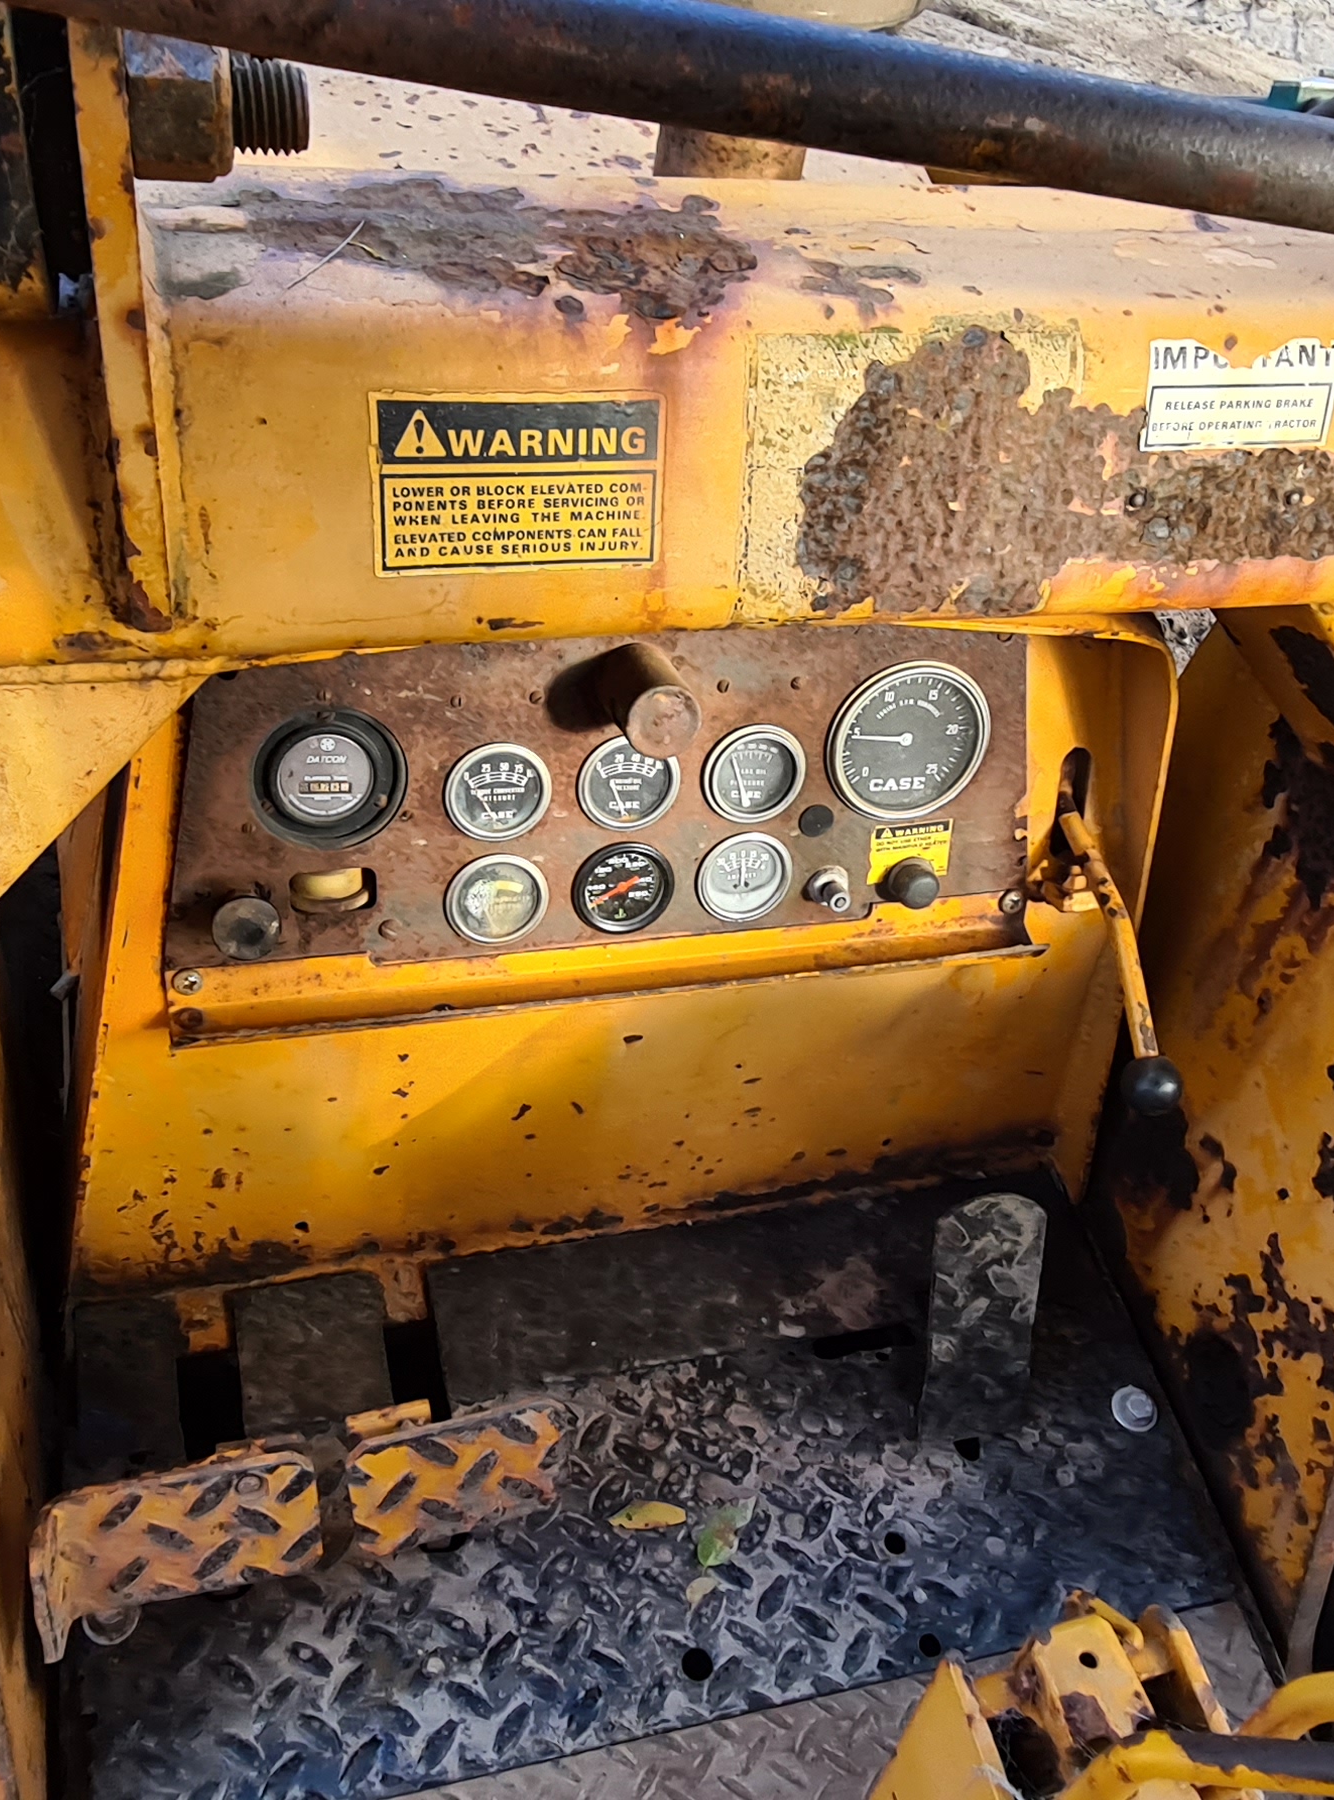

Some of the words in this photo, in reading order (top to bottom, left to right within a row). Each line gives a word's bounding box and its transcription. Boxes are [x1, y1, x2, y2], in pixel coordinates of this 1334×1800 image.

[1165, 400, 1216, 411] RELEASE
[1219, 399, 1272, 410] PARKING
[1276, 398, 1314, 409] BRAKE
[447, 426, 647, 457] WARNING
[392, 486, 444, 498] LOWER
[450, 485, 471, 497] OR
[476, 484, 525, 497] BLOCK
[531, 483, 603, 496] ELEVATED
[609, 482, 647, 494] COM-
[393, 499, 468, 512] PONENTS
[477, 498, 536, 510] BEFORE
[543, 496, 619, 508] SERVICING
[626, 496, 645, 507] OR
[393, 514, 441, 527] WHEN
[451, 513, 520, 525] LEAVING
[531, 511, 561, 523] THE
[570, 510, 645, 522] MACHINE.
[394, 532, 466, 545] ELEVATED
[471, 529, 572, 542] COMPONENTS
[577, 528, 607, 539] CAN
[612, 527, 643, 538] FALL
[395, 546, 431, 559] AND
[438, 544, 494, 557] CAUSE
[501, 542, 572, 555] SERIOUS
[580, 540, 644, 553] INJURY.
[884, 690, 895, 703] 10
[928, 689, 939, 701] 15
[854, 727, 862, 737] 5
[945, 724, 960, 735] 20
[305, 755, 348, 764] DATCON
[614, 753, 625, 764] 20
[481, 763, 492, 773] 25
[499, 761, 510, 772] 50
[862, 766, 869, 777] 0
[925, 763, 939, 775] 25
[869, 776, 926, 792] CASE
[730, 790, 762, 799] CSE
[895, 824, 944, 837] WARNING
